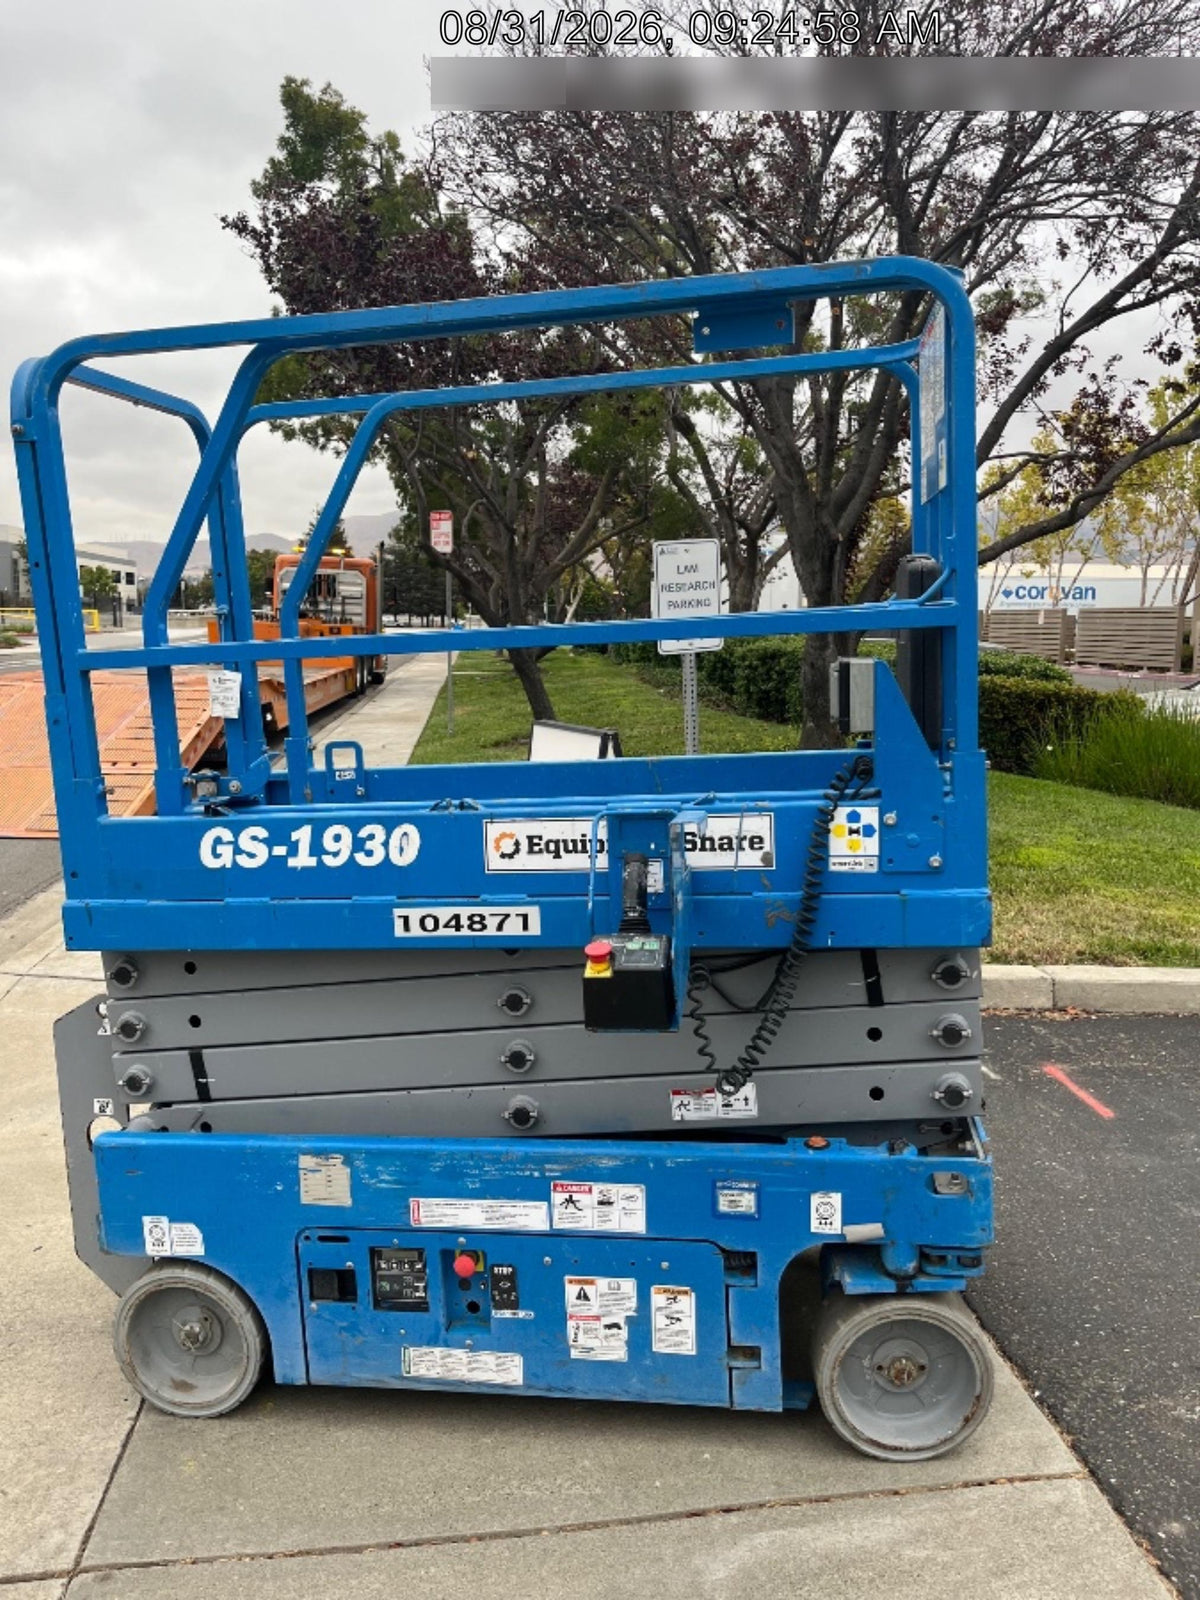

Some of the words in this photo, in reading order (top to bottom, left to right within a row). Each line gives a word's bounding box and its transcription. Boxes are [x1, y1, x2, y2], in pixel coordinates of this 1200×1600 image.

[660, 580, 716, 593] RESEARCH
[667, 598, 711, 610] PARKING
[199, 823, 421, 869] GS-1930
[397, 912, 529, 933] 104871
